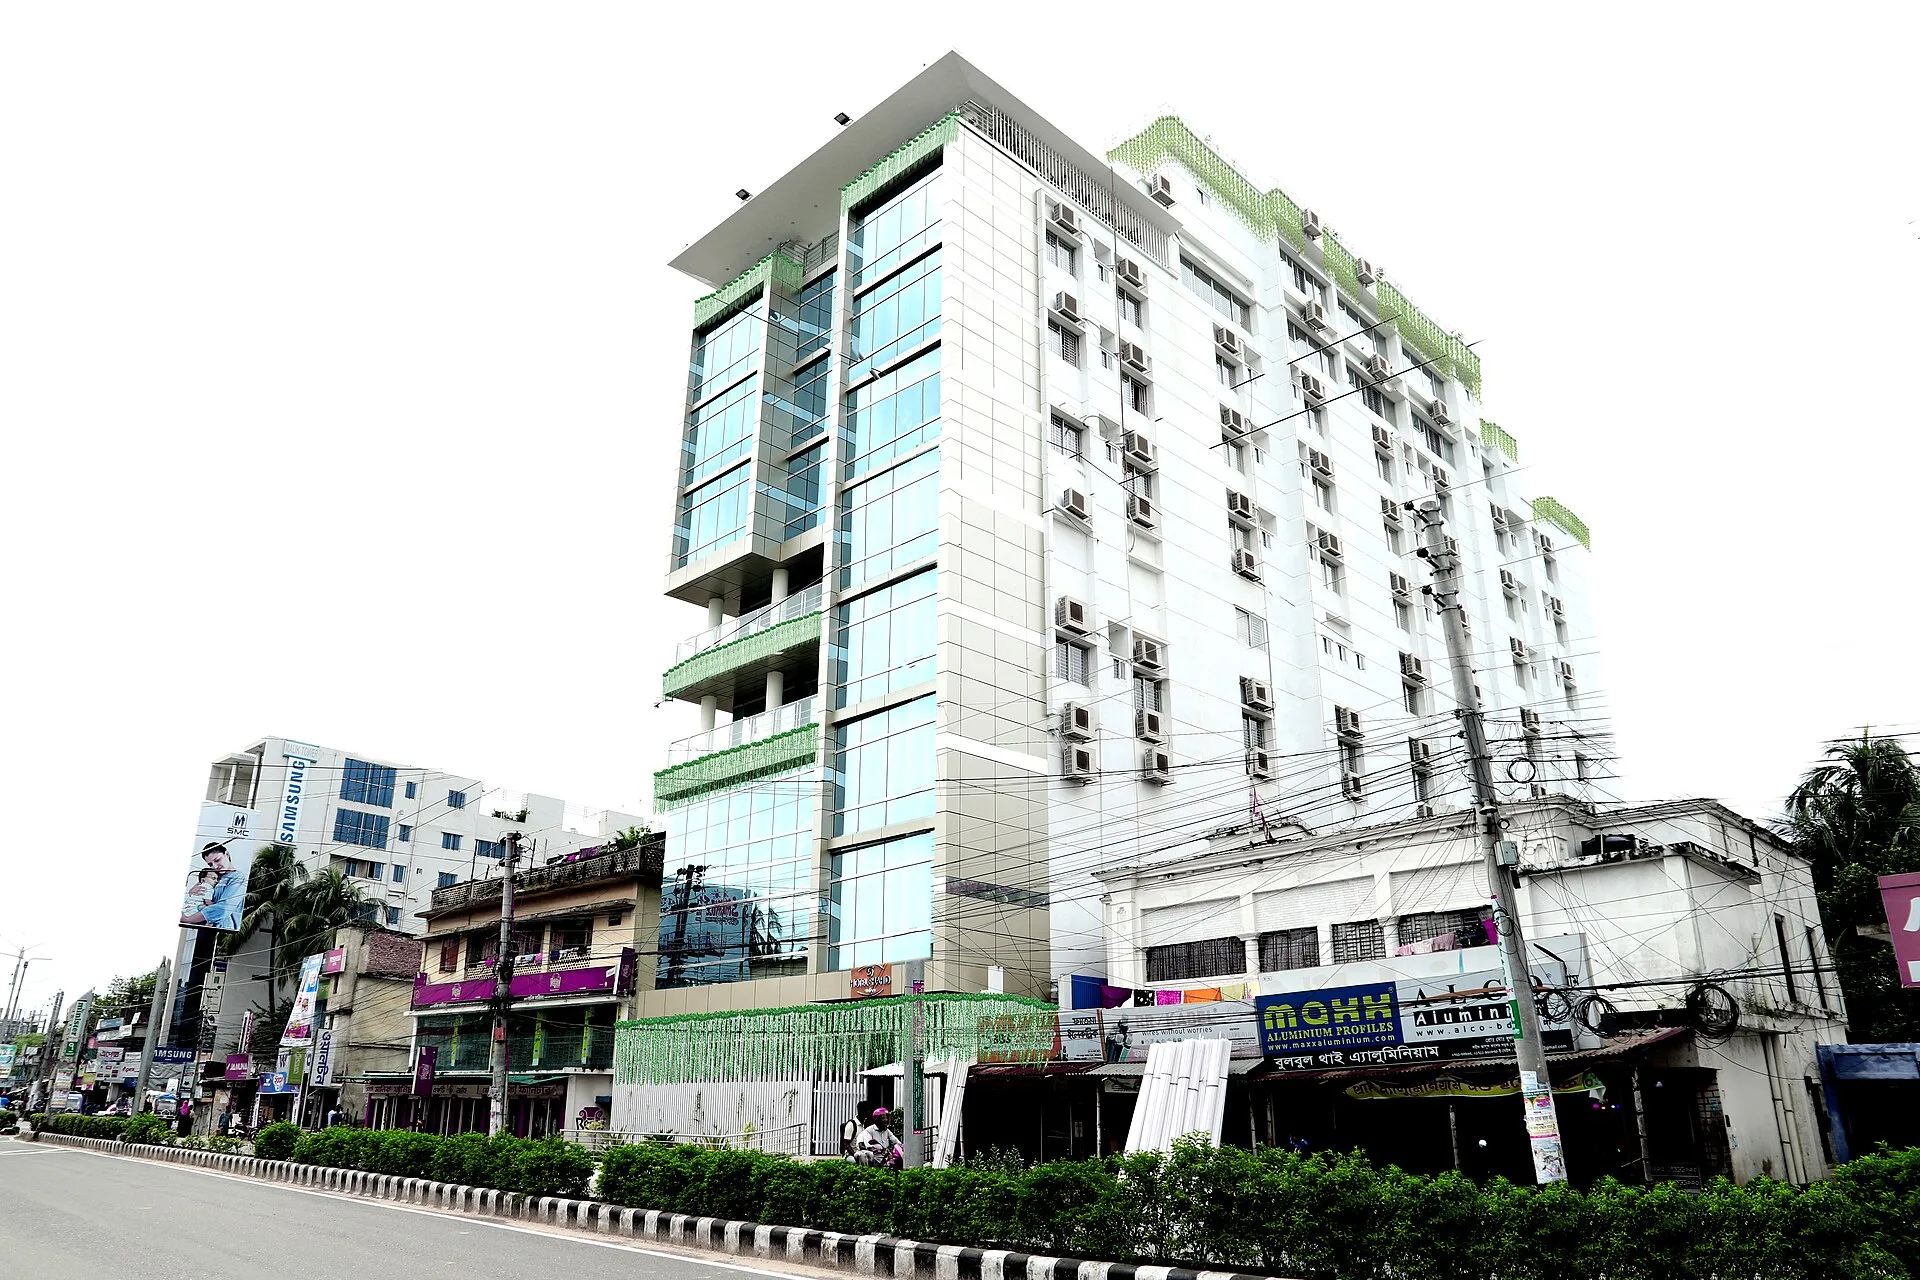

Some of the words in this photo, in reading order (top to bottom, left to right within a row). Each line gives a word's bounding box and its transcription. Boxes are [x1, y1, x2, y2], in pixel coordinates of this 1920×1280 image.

[281, 760, 305, 843] SAMSUNG
[227, 828, 250, 837] SMC
[71, 1002, 85, 1036] minister
[1160, 1026, 1185, 1035] without
[1187, 1026, 1213, 1034] worries
[1267, 1028, 1333, 1042] ALUMINIUM
[1337, 1021, 1394, 1036] PROFILES
[1268, 1034, 1396, 1051] www.maxxaluminium.com
[153, 1049, 193, 1059] AMSUNG
[1274, 1055, 1314, 1070] বুলবুল
[1318, 1050, 1346, 1066] থাই
[1350, 1045, 1440, 1064] এ্যালুমিনিয়াম
